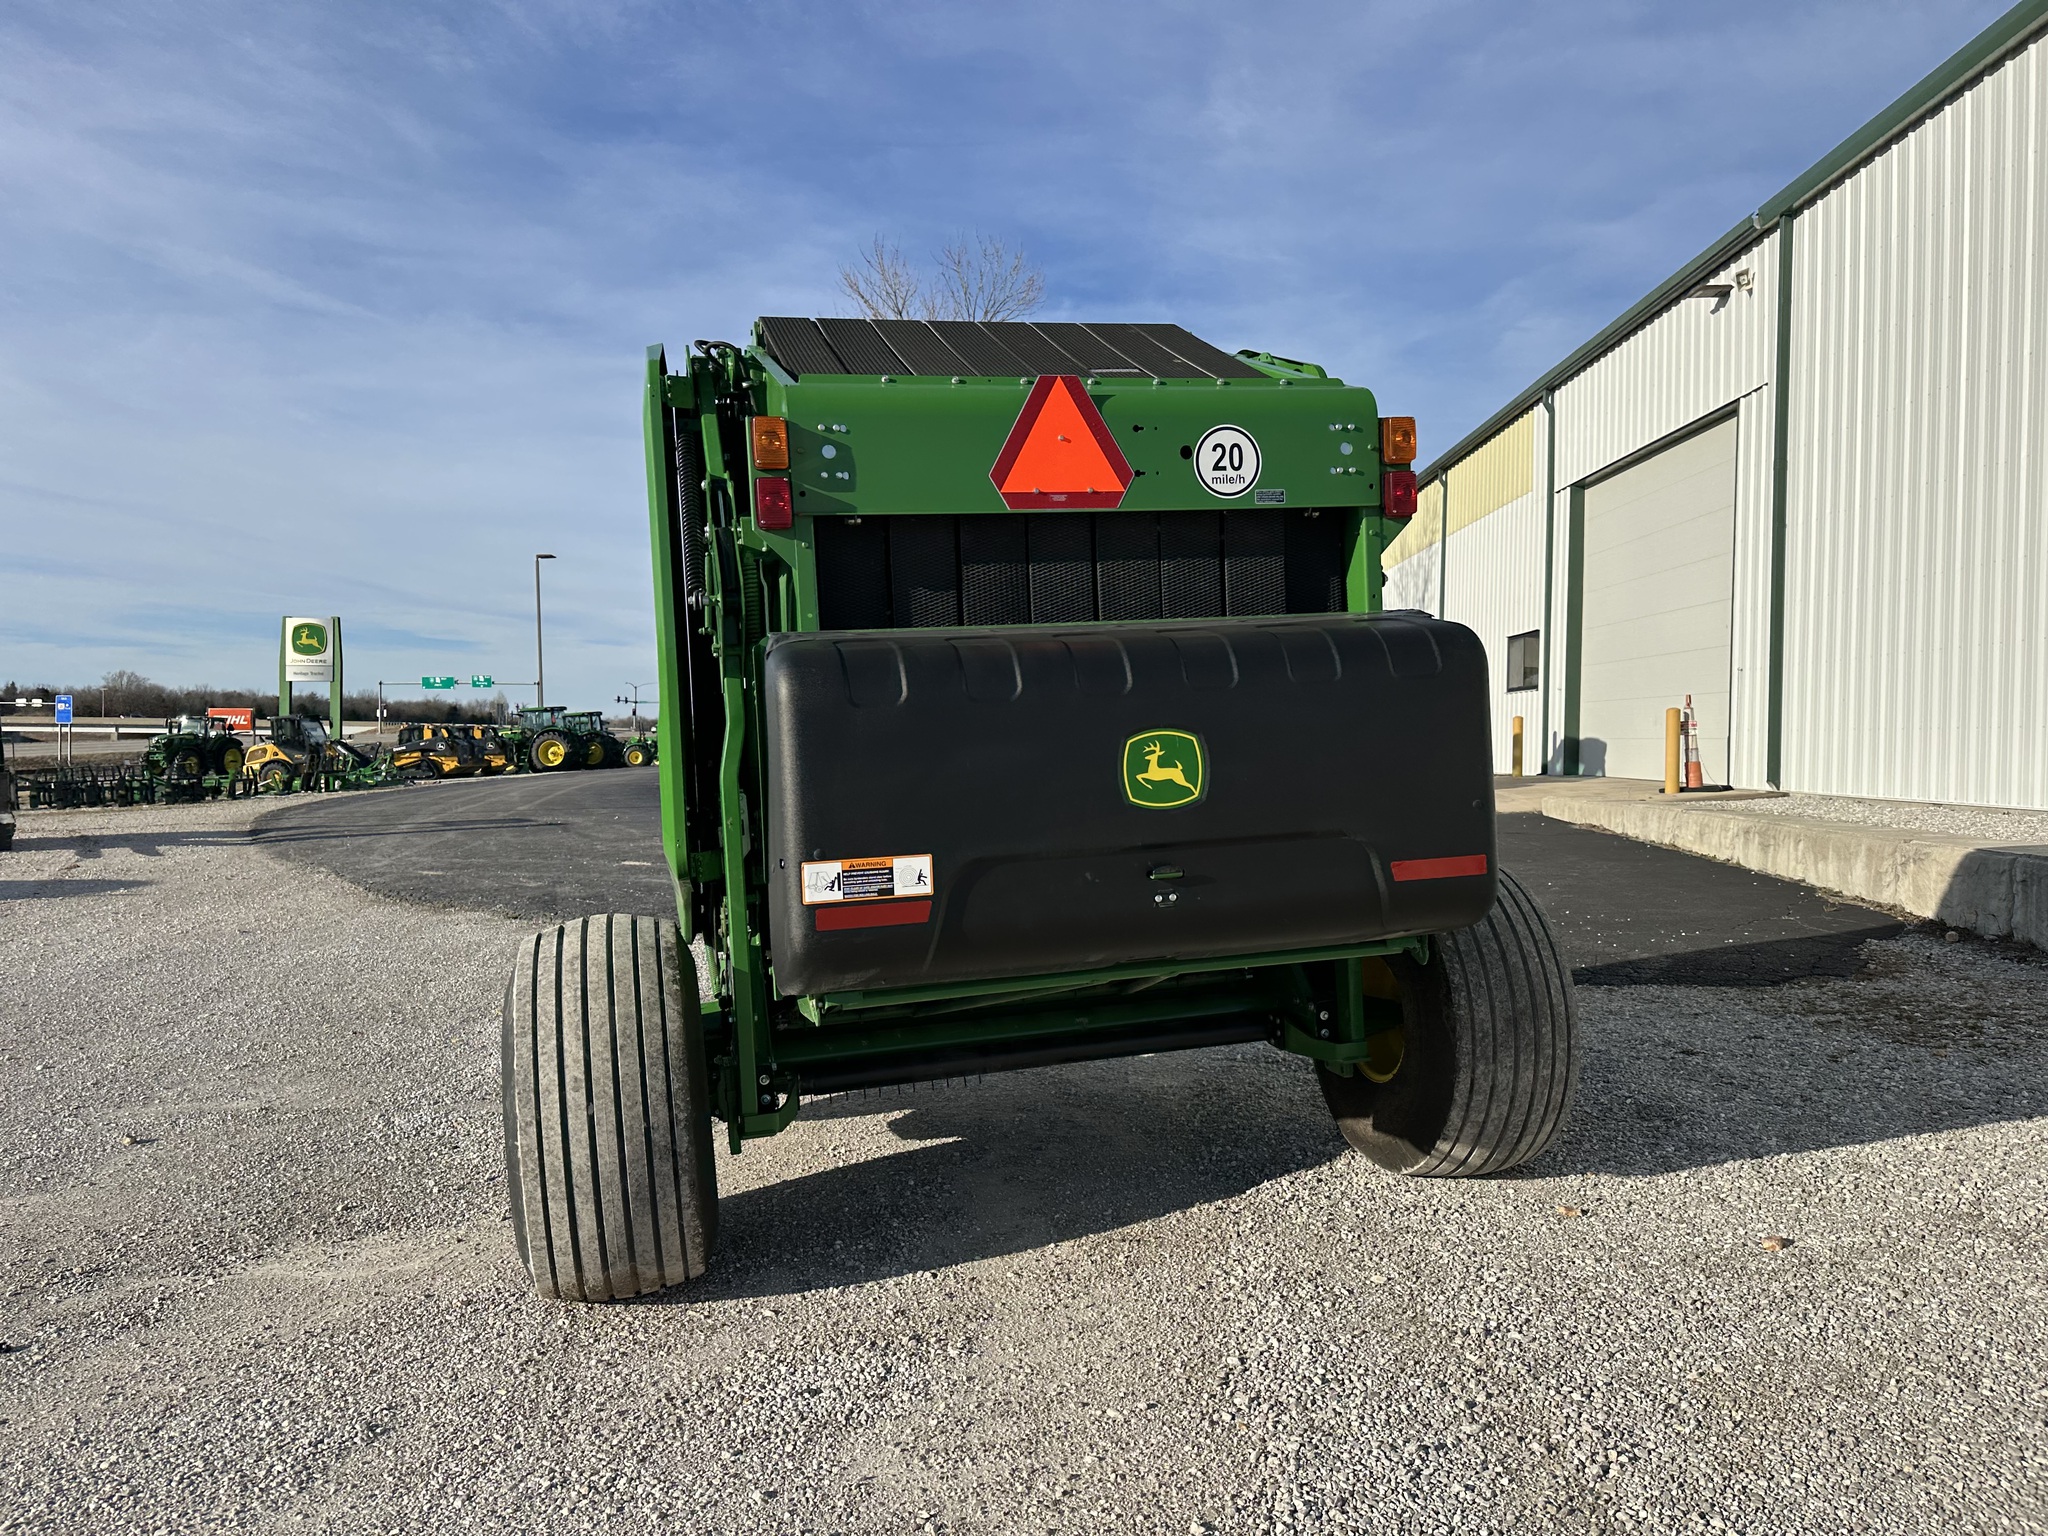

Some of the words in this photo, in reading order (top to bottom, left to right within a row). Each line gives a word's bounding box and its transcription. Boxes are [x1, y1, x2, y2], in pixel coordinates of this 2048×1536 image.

[1211, 443, 1243, 471] 20
[1211, 474, 1245, 485] mile/h
[855, 860, 886, 868] WARNING
